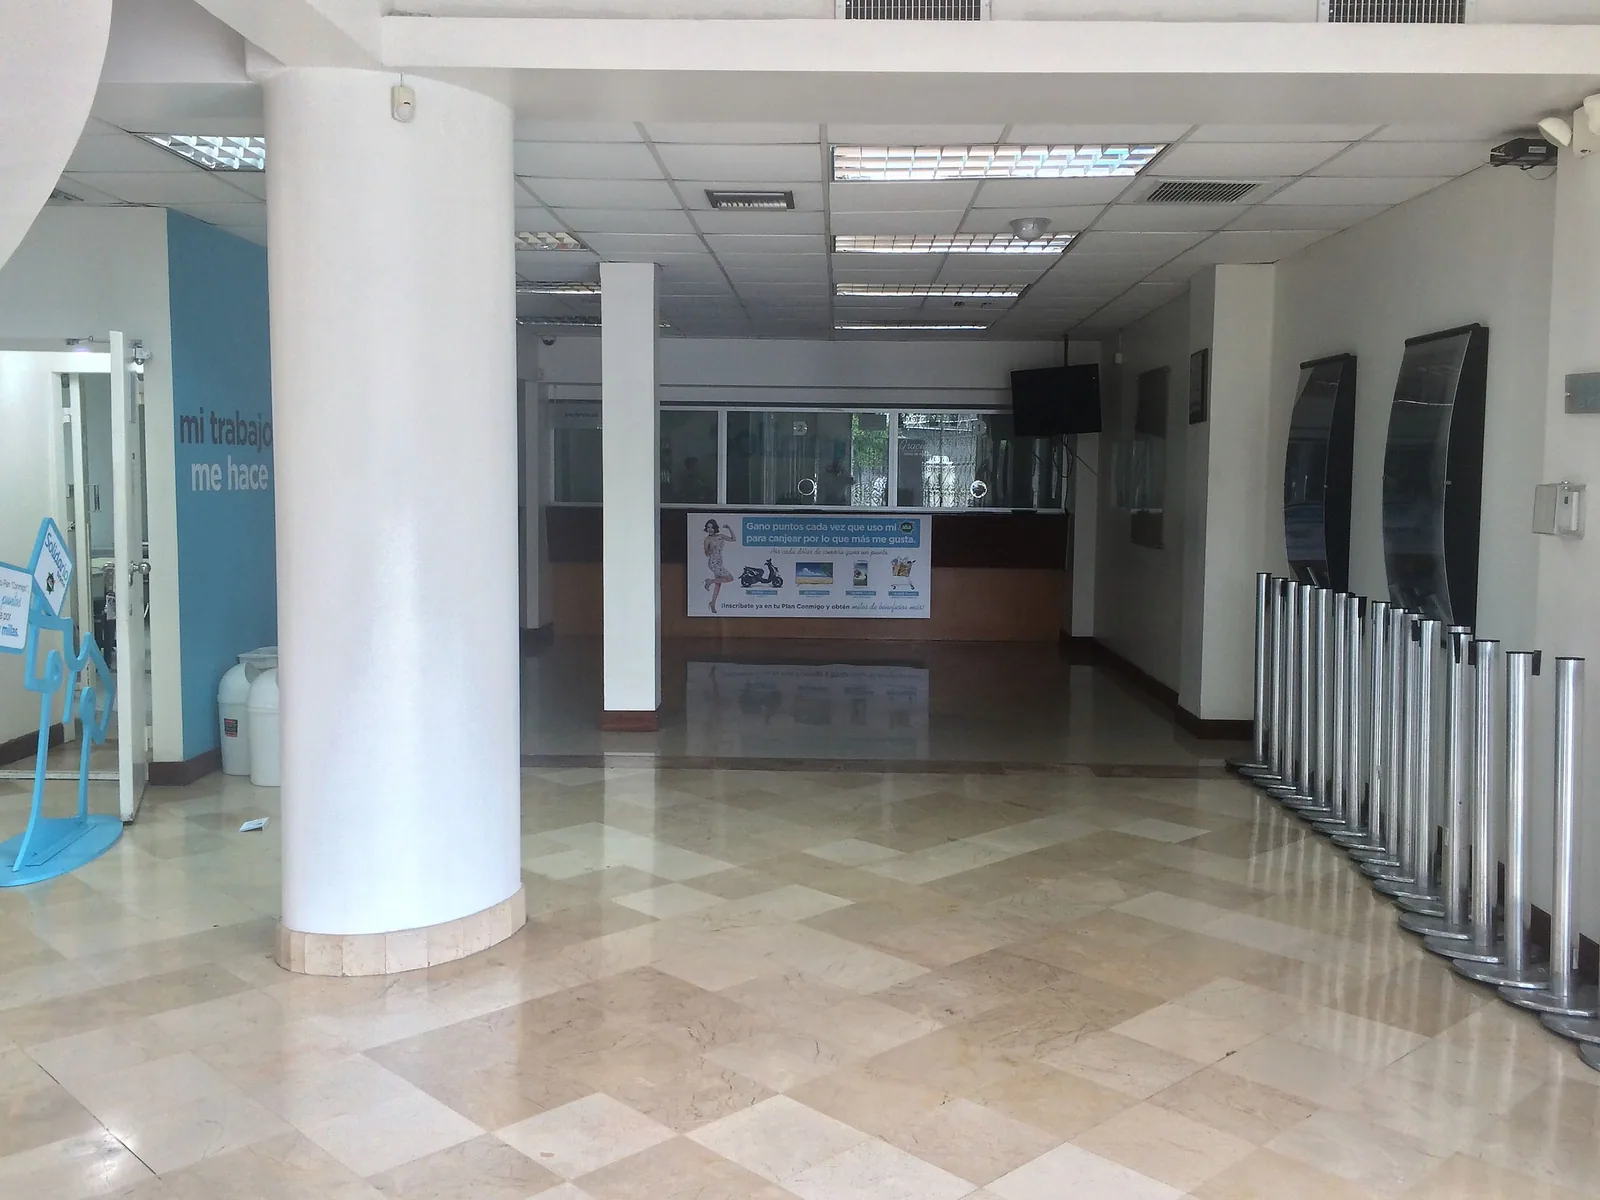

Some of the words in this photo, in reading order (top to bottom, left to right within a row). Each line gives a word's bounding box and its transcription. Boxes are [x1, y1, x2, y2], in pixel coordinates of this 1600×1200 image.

[179, 406, 204, 444] mi
[209, 410, 273, 453] trabajo
[191, 463, 222, 491] me
[227, 454, 268, 490] hace
[746, 522, 770, 531] Gano
[772, 523, 804, 532] puntos
[806, 522, 827, 531] cada
[847, 524, 864, 532] que
[885, 523, 897, 532] mi
[746, 535, 766, 544] para
[769, 534, 802, 544] canjear
[803, 536, 821, 544] por
[821, 534, 830, 543] lo
[832, 536, 849, 544] que
[851, 534, 870, 543] más
[888, 535, 916, 544] gusta.
[45, 532, 69, 581] Solidario
